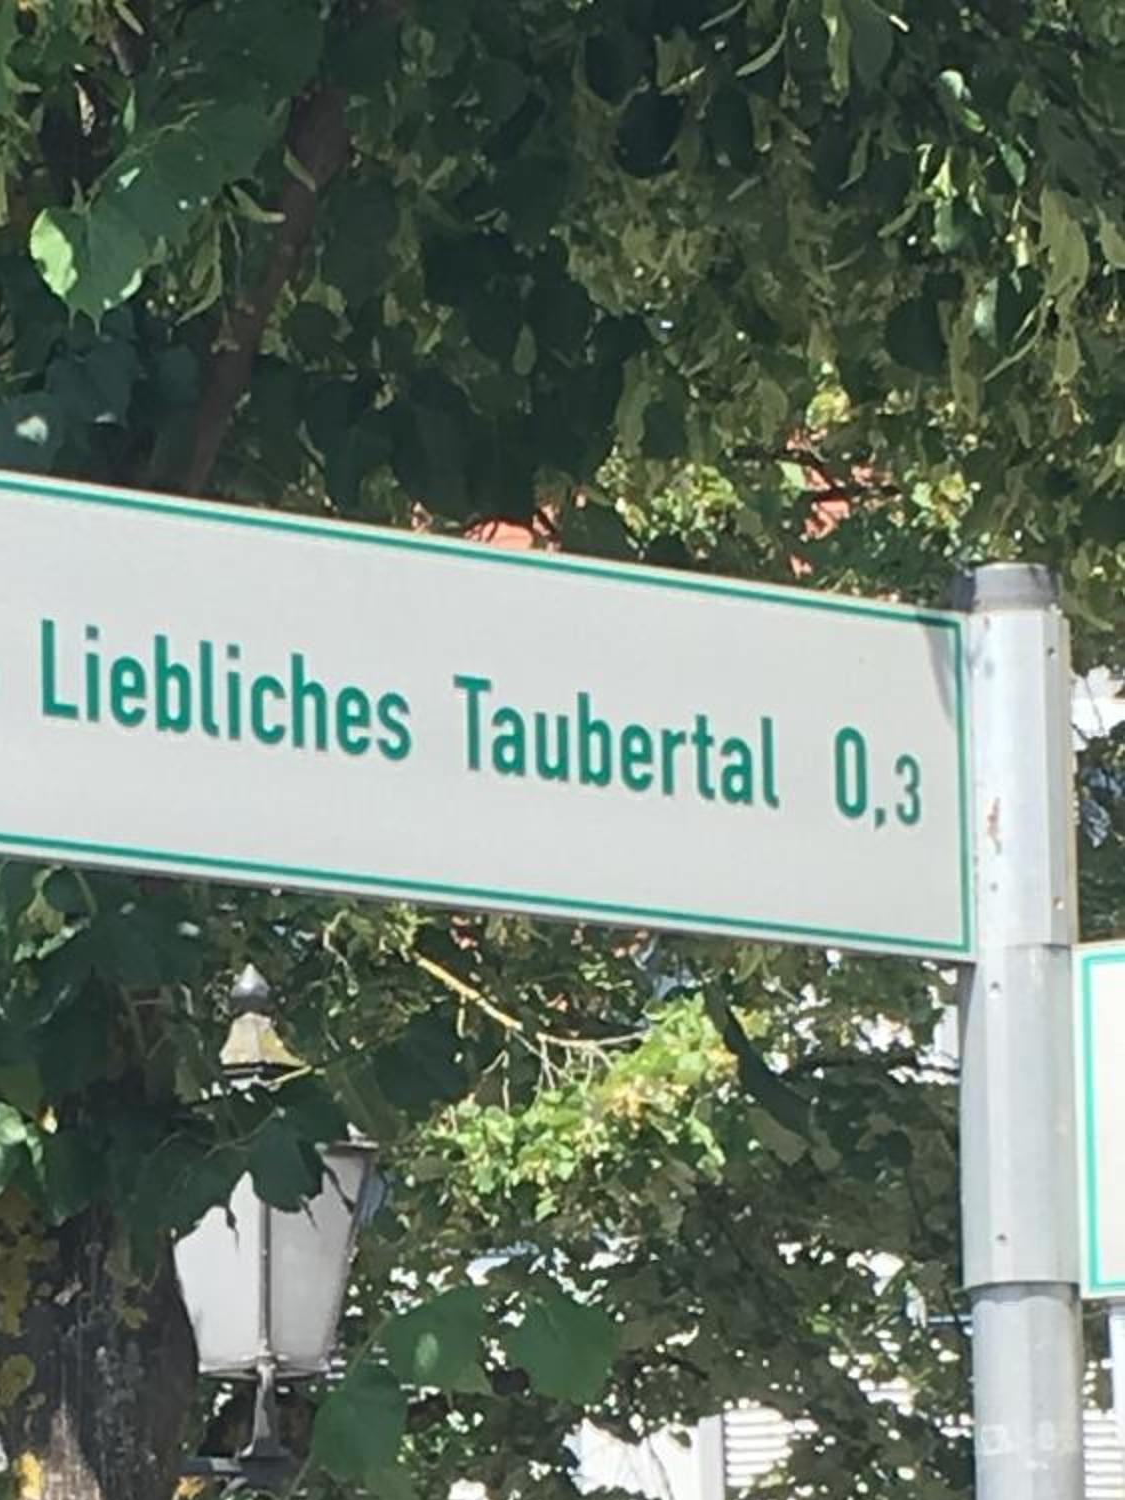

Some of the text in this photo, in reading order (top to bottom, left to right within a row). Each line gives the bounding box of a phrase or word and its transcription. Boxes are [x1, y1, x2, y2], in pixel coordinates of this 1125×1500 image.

[41, 618, 922, 829] Liebliches Taubertal 0,3
